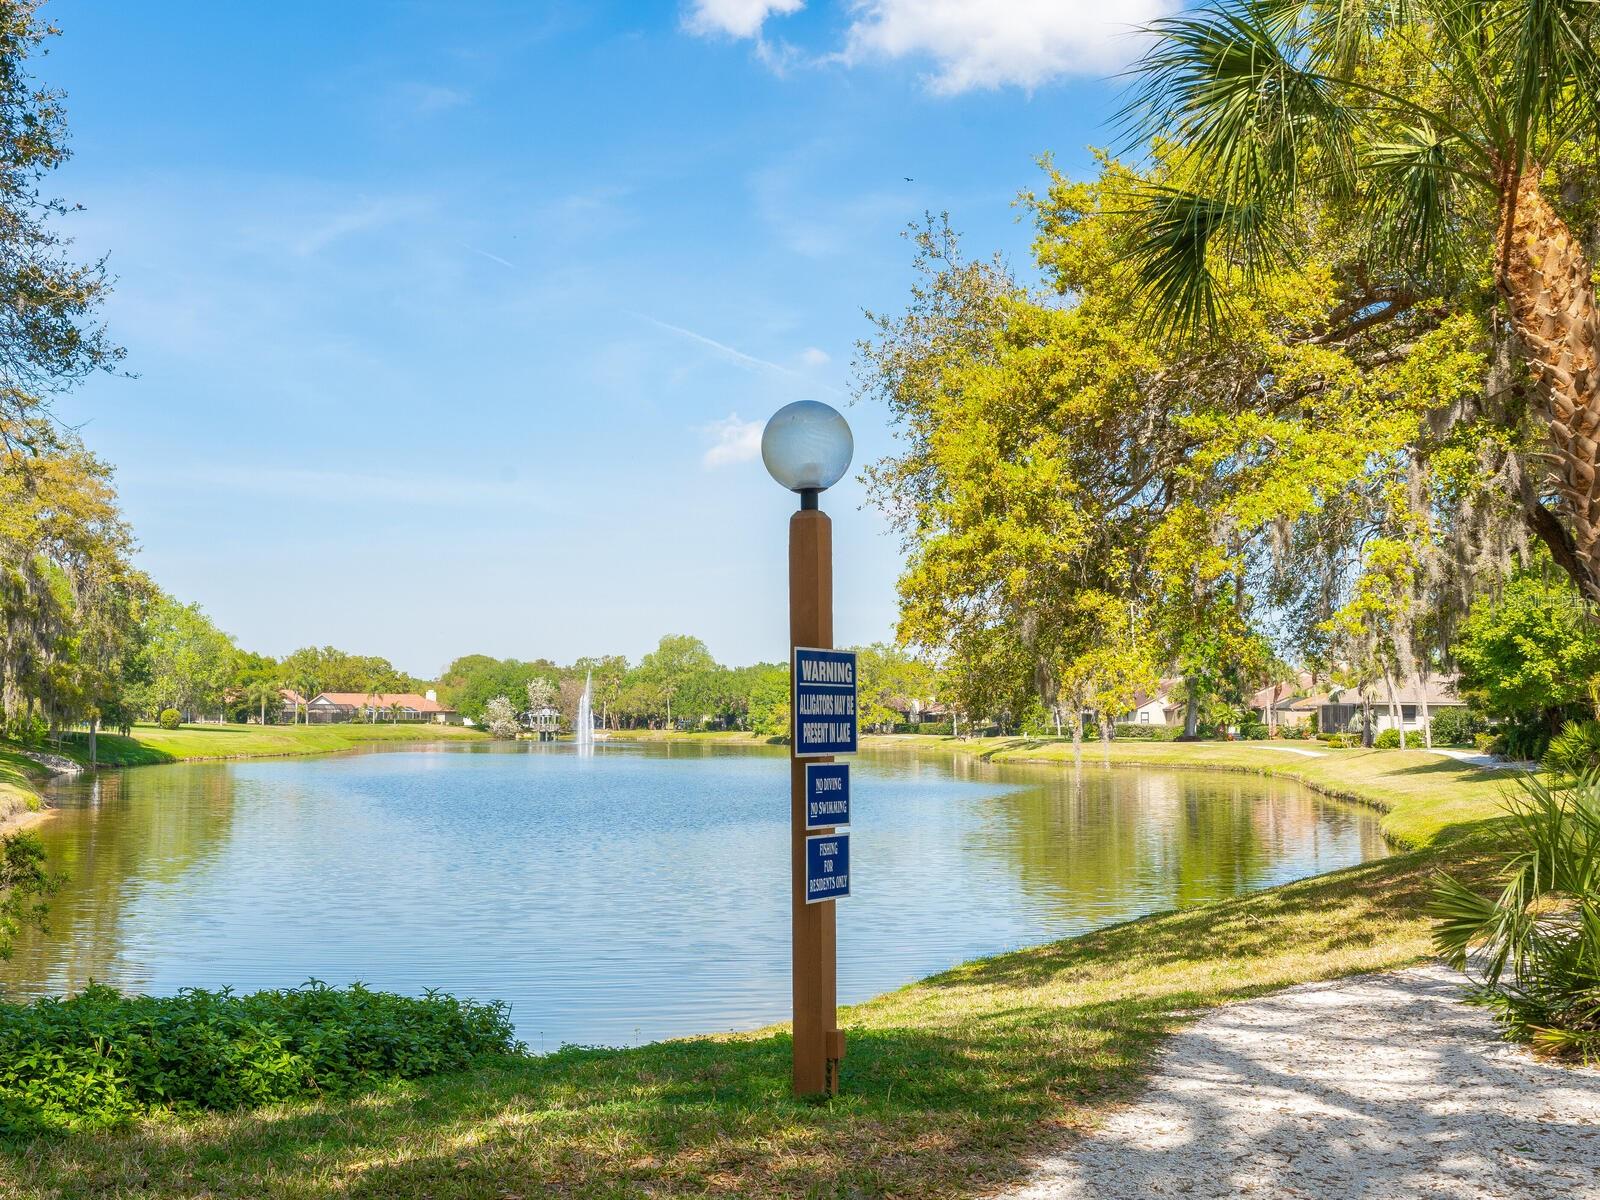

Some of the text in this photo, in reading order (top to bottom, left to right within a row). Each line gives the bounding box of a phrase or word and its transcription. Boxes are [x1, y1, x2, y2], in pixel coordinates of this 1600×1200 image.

[801, 660, 852, 683] WARNING
[799, 694, 855, 715] ALLIGATORS MAY BE
[803, 722, 850, 743] PRESENT IN LAKE
[816, 778, 842, 791] NO DIVING
[811, 801, 847, 815] NO SWIMMING
[820, 843, 838, 856] FISHING
[824, 860, 833, 873] FOR
[810, 876, 847, 892] RESIDENTS ONLY
